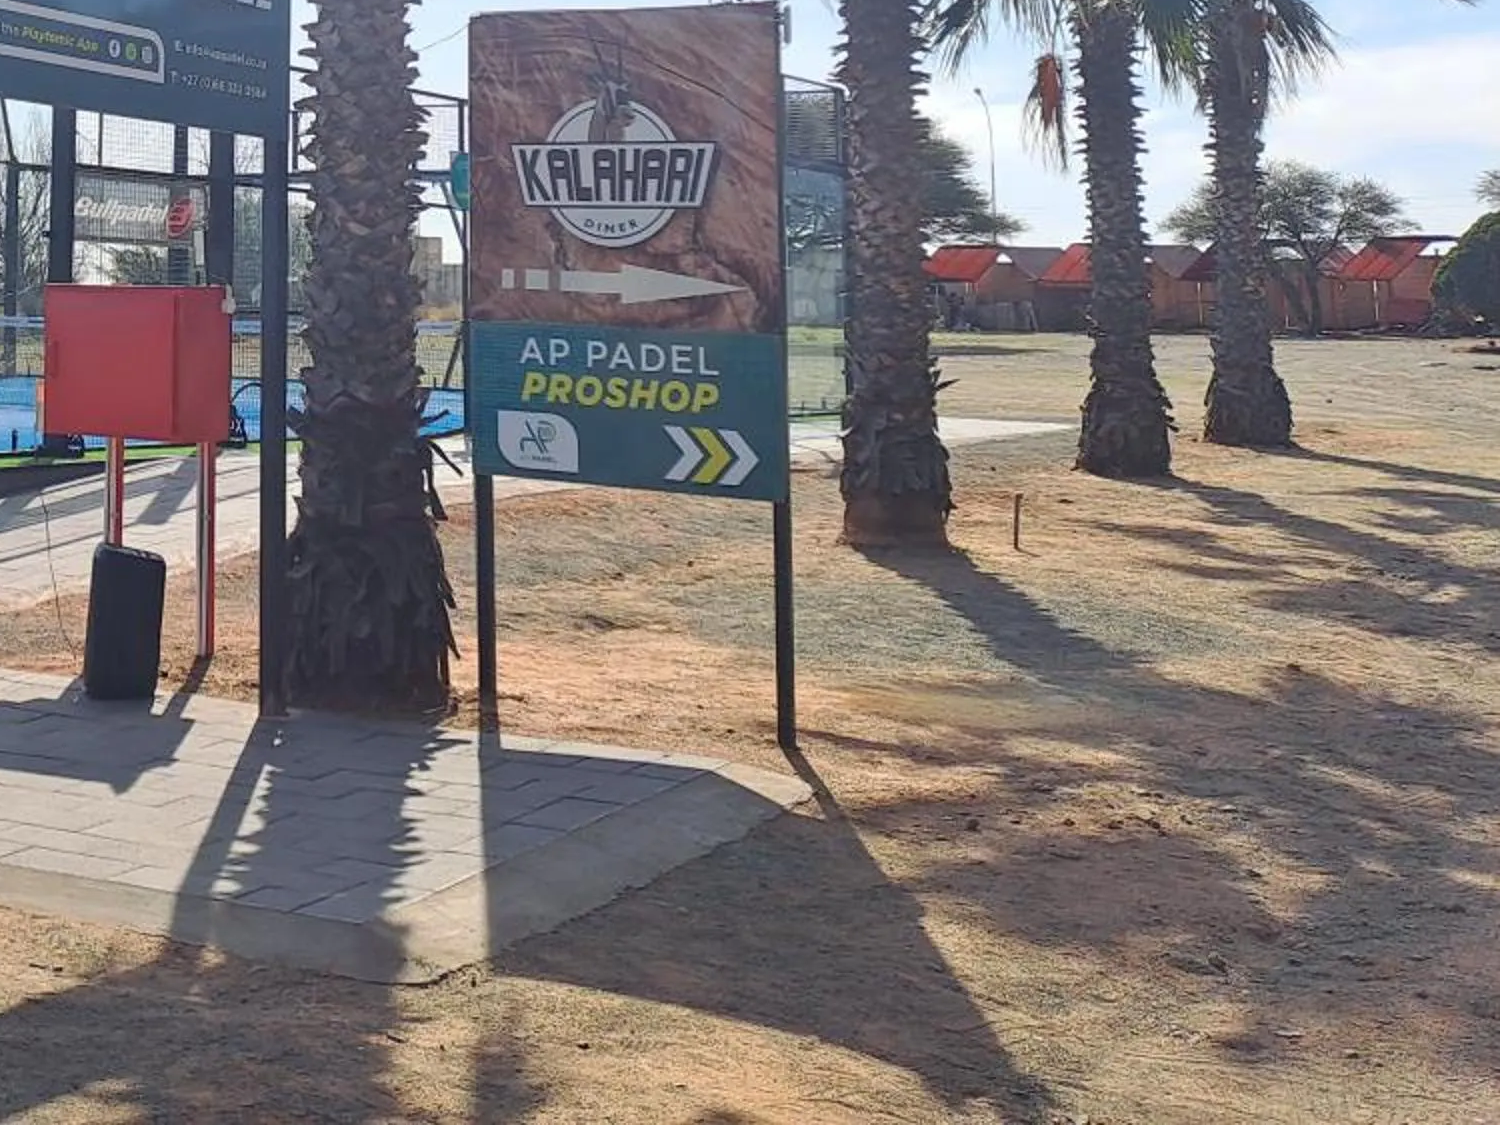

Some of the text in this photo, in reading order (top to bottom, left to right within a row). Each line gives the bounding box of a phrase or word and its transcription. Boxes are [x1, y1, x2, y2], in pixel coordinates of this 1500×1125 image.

[518, 147, 706, 203] KALAHARI
[583, 217, 640, 234] DINER
[519, 336, 720, 376] AP PADEL
[520, 371, 720, 414] PROSHOP
